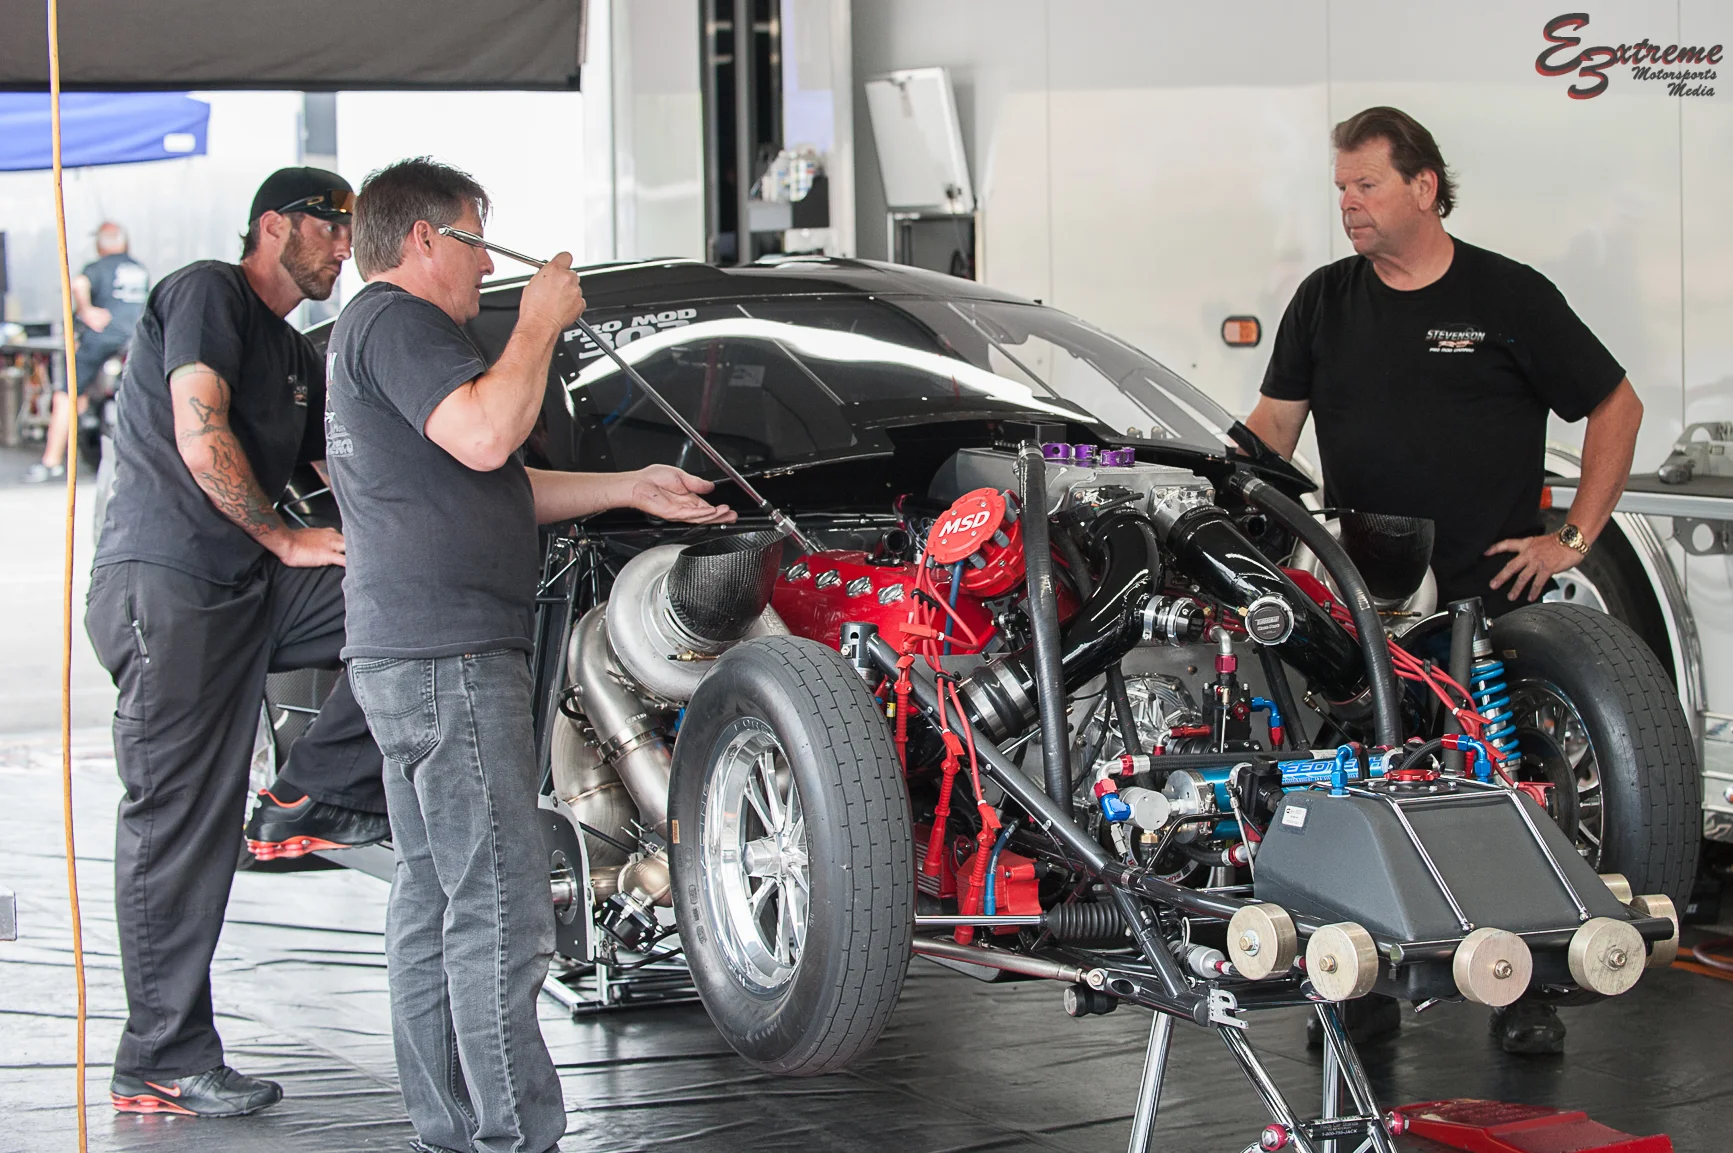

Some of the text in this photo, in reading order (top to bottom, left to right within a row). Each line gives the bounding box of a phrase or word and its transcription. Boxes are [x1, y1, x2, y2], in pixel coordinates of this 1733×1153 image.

[631, 308, 697, 328] MOD
[1425, 329, 1486, 341] STEVENSON
[938, 510, 991, 538] MSD
